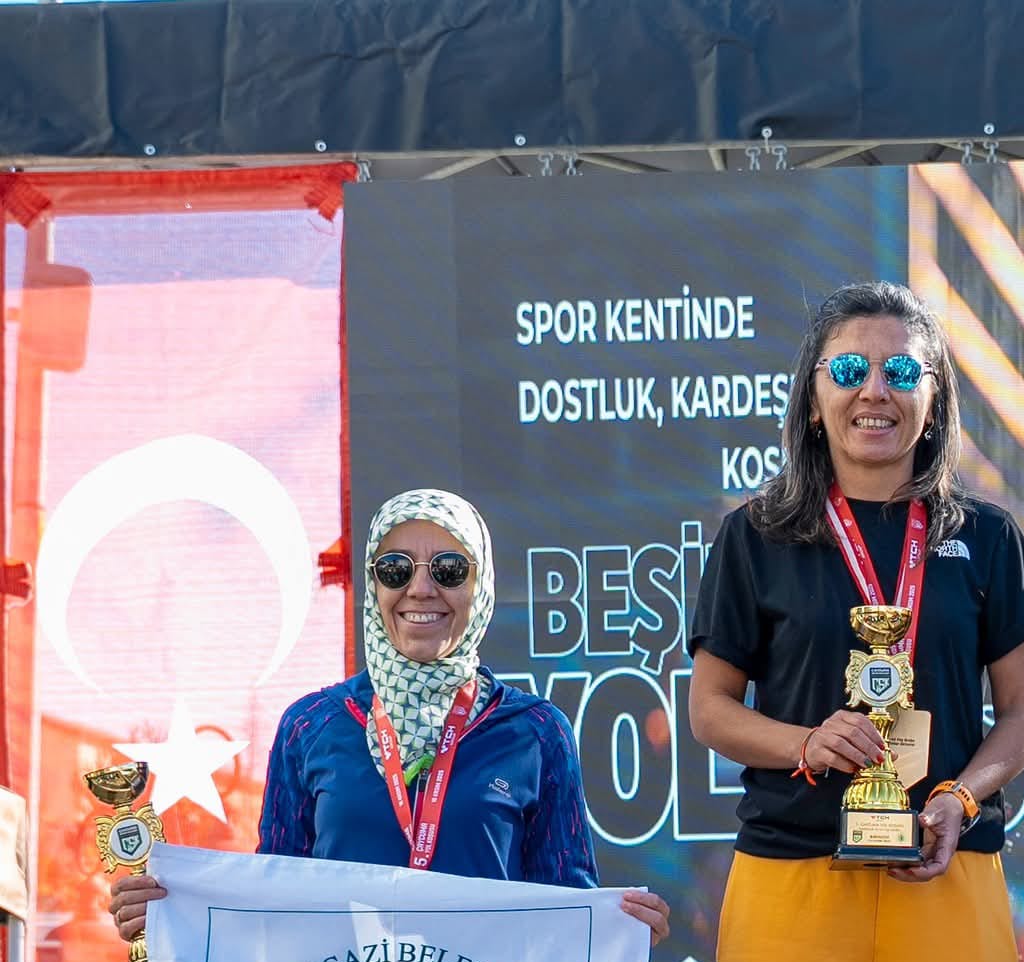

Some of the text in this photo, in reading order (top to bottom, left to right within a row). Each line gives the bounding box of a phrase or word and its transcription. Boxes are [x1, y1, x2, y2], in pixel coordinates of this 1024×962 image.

[516, 284, 755, 345] SPOR KENTİNDE
[518, 373, 795, 429] DOSTLUK, KARDEŞ
[527, 520, 713, 675] BEŞİ
